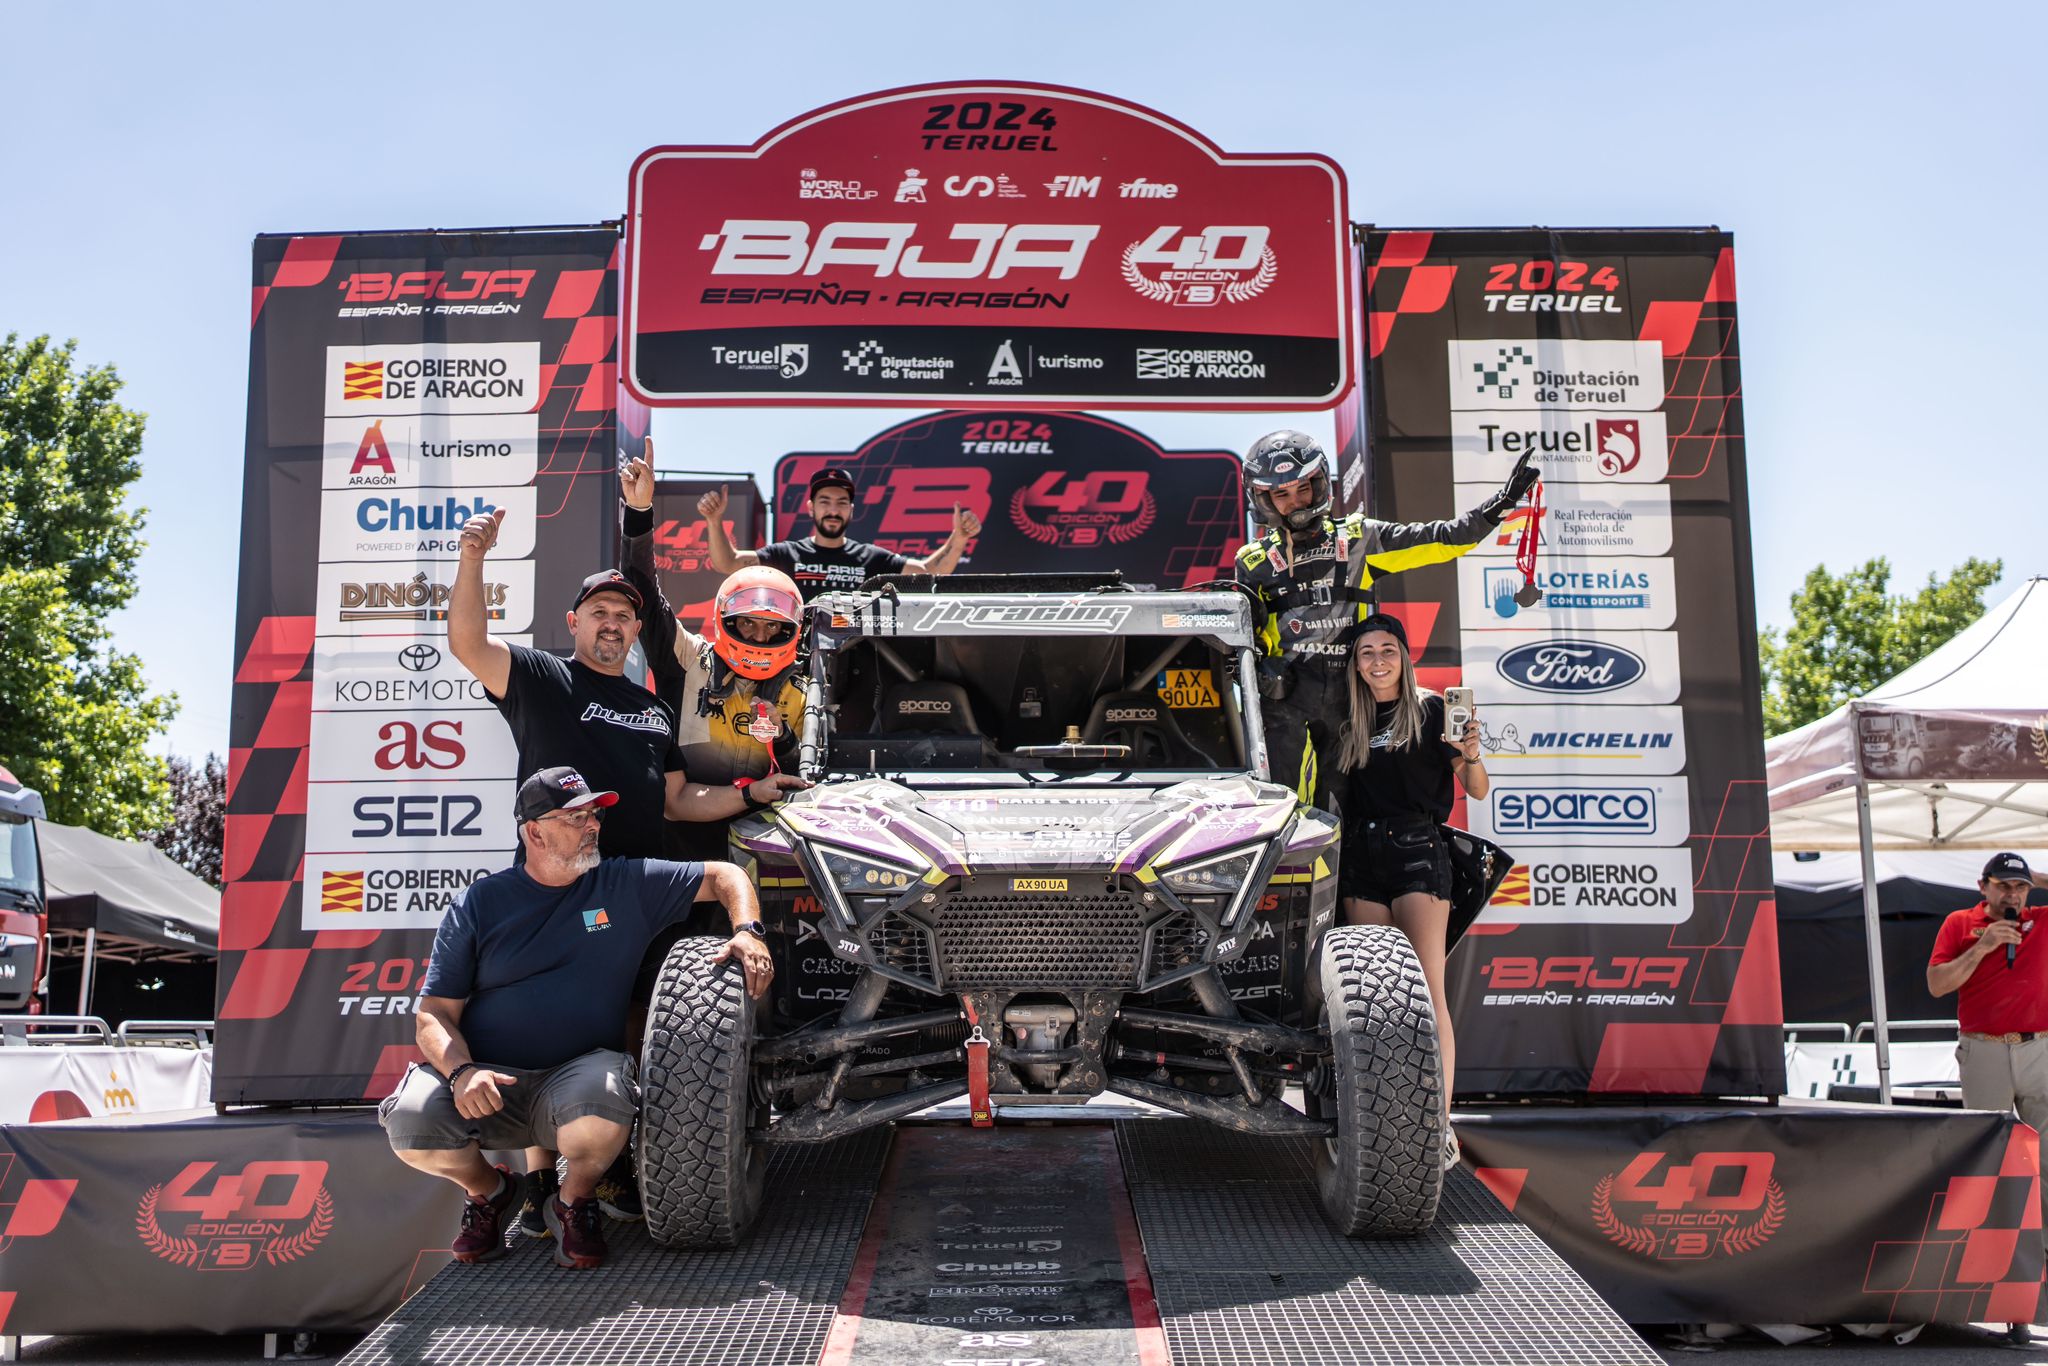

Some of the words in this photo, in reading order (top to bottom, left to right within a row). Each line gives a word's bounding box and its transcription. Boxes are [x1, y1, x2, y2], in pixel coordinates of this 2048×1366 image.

[922, 102, 1057, 131] 2024
[921, 135, 1058, 151] TERUEL
[800, 180, 861, 190] WORLD
[1044, 176, 1101, 197] FIM
[1119, 177, 1179, 198] rfme
[699, 219, 1101, 280] BAJA
[1129, 226, 1271, 269] 40
[1159, 269, 1239, 281] EDICIÓN
[1483, 260, 1620, 291] 2024
[338, 269, 537, 302] BAJA
[700, 283, 871, 305] ESPAÑA
[896, 288, 1070, 309] ARAGÓN
[1483, 294, 1622, 313] TERUEL
[338, 303, 422, 317] ESPAÑA
[433, 302, 521, 315] ARAGÓN
[711, 345, 780, 364] Teruel
[881, 356, 954, 369] Diputación
[1037, 354, 1104, 369] turismo
[1168, 350, 1253, 364] GOBIERNO
[386, 358, 507, 378] GOBIERNO
[881, 368, 899, 379] de
[902, 368, 944, 380] Teruel
[1168, 364, 1191, 378] DE
[1195, 364, 1265, 378] ARAGON
[987, 376, 1023, 386] ARAGÓN
[1532, 370, 1640, 388] Diputación
[386, 380, 416, 399] DE
[423, 379, 523, 398] ARAGON
[1534, 389, 1560, 402] de
[1565, 388, 1626, 403] Teruel
[962, 420, 1053, 440] 2024
[1479, 422, 1592, 453] Teruel
[421, 440, 511, 457] turismo
[961, 441, 1054, 454] TERUEL
[349, 474, 397, 486] ARAGÓN
[1023, 471, 1150, 512] 40
[1047, 513, 1121, 523] EDICIÓN
[1554, 510, 1575, 520] Real
[1578, 509, 1632, 521] Federación
[1563, 523, 1608, 534] Española
[1612, 522, 1625, 532] de
[356, 543, 402, 552] POWERED
[405, 543, 416, 551] BY
[1557, 535, 1634, 546] Automovilismo
[794, 562, 866, 576] POLARIS
[803, 580, 856, 588] IBERIA
[825, 574, 865, 584] RACING
[1537, 568, 1650, 589] LOTERÍAS
[340, 571, 510, 608] DINÓPIS
[1551, 597, 1573, 605] CON
[1576, 597, 1588, 605] EL
[1591, 597, 1639, 605] DEPORTE
[863, 621, 903, 629] ARAGON
[1180, 614, 1228, 622] GOBIERNO
[1305, 619, 1327, 630] CARS
[1292, 642, 1348, 655] MAXXIS
[1526, 646, 1614, 685] Ford
[1174, 671, 1202, 688] AX
[899, 700, 951, 713] sparco
[1106, 708, 1157, 721] sparco
[374, 720, 466, 770] as
[1528, 732, 1673, 748] MICHELIN
[352, 795, 482, 838] SER
[1499, 792, 1649, 827] sparco
[1533, 864, 1658, 885] GOBIERNO
[366, 893, 398, 912] DE
[405, 892, 453, 912] ARA
[1533, 887, 1566, 907] DE
[1575, 887, 1677, 907] ARAGON
[1480, 956, 1690, 989] BAJA
[1482, 991, 1572, 1006] ESPAÑA
[1586, 991, 1675, 1006] ARAGÓN
[1613, 1151, 1776, 1210] 40
[156, 1160, 329, 1220] 40
[1641, 1210, 1738, 1226] EDICIÓN
[184, 1220, 285, 1236] EDICIÓN
[937, 1241, 1024, 1250] Teruel
[936, 1261, 1061, 1272] Chubb
[916, 1315, 1077, 1324] KOBEMOTOR
[958, 1333, 1033, 1347] as
